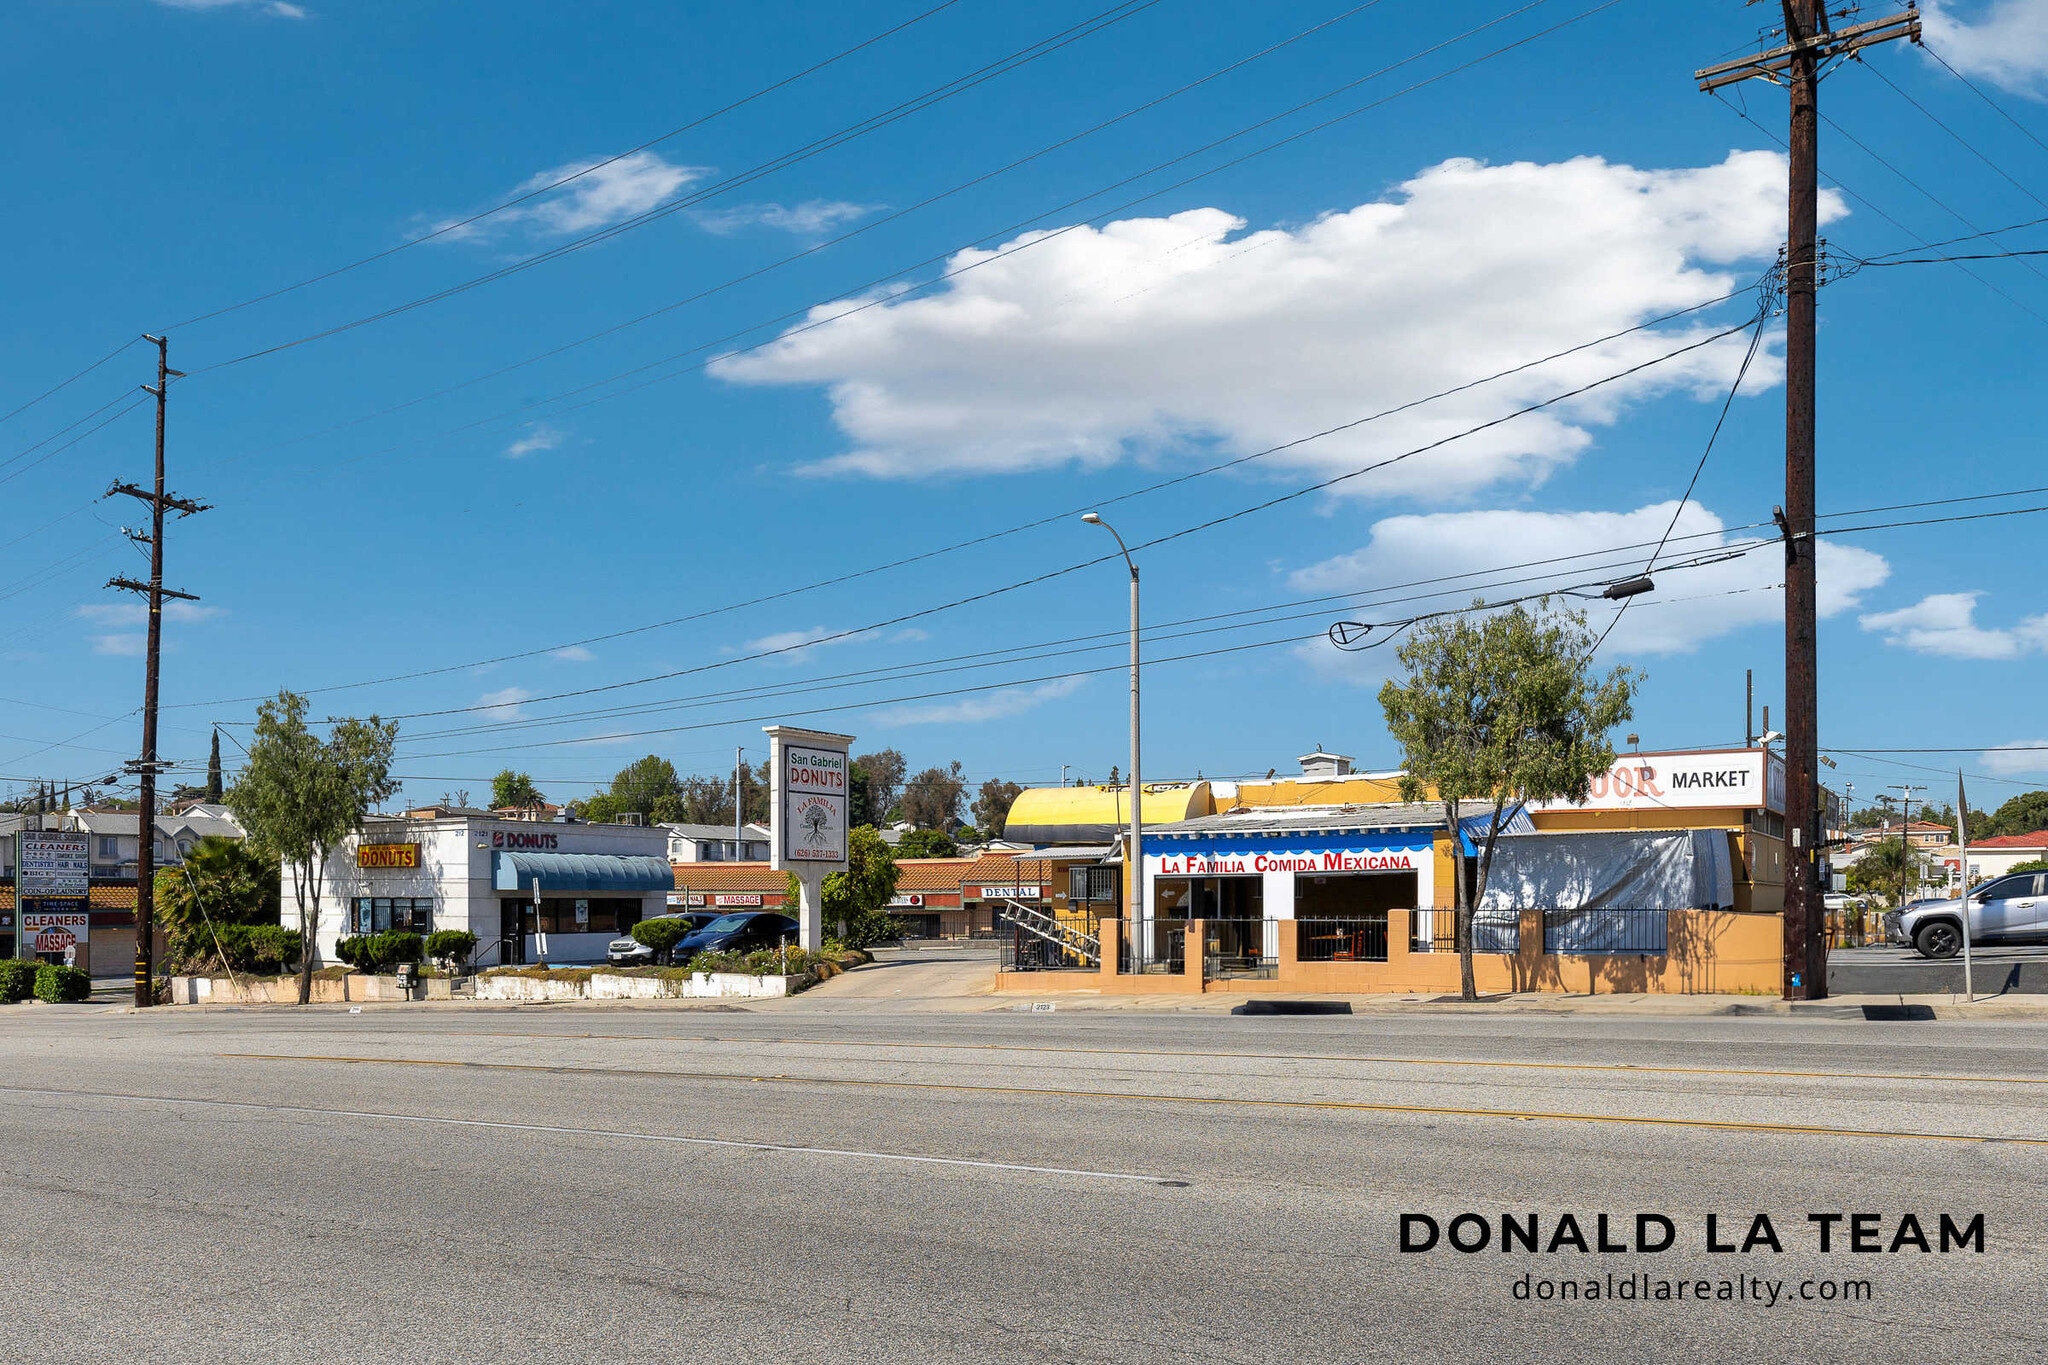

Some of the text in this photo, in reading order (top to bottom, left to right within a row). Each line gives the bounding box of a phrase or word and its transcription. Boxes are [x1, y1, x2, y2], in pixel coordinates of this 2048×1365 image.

[791, 753, 842, 769] San Gabriel
[790, 767, 843, 788] DONUTS
[1672, 770, 1750, 789] MARKET
[807, 796, 837, 817] FAMILIA
[25, 842, 86, 851] CLEANERS
[507, 832, 559, 850] DONUTS
[361, 850, 413, 866] DONUTS
[723, 895, 760, 905] MASSAGE
[986, 888, 1036, 897] DENTAL
[24, 915, 87, 926] CLEANERS
[35, 934, 76, 952] MASSAGE
